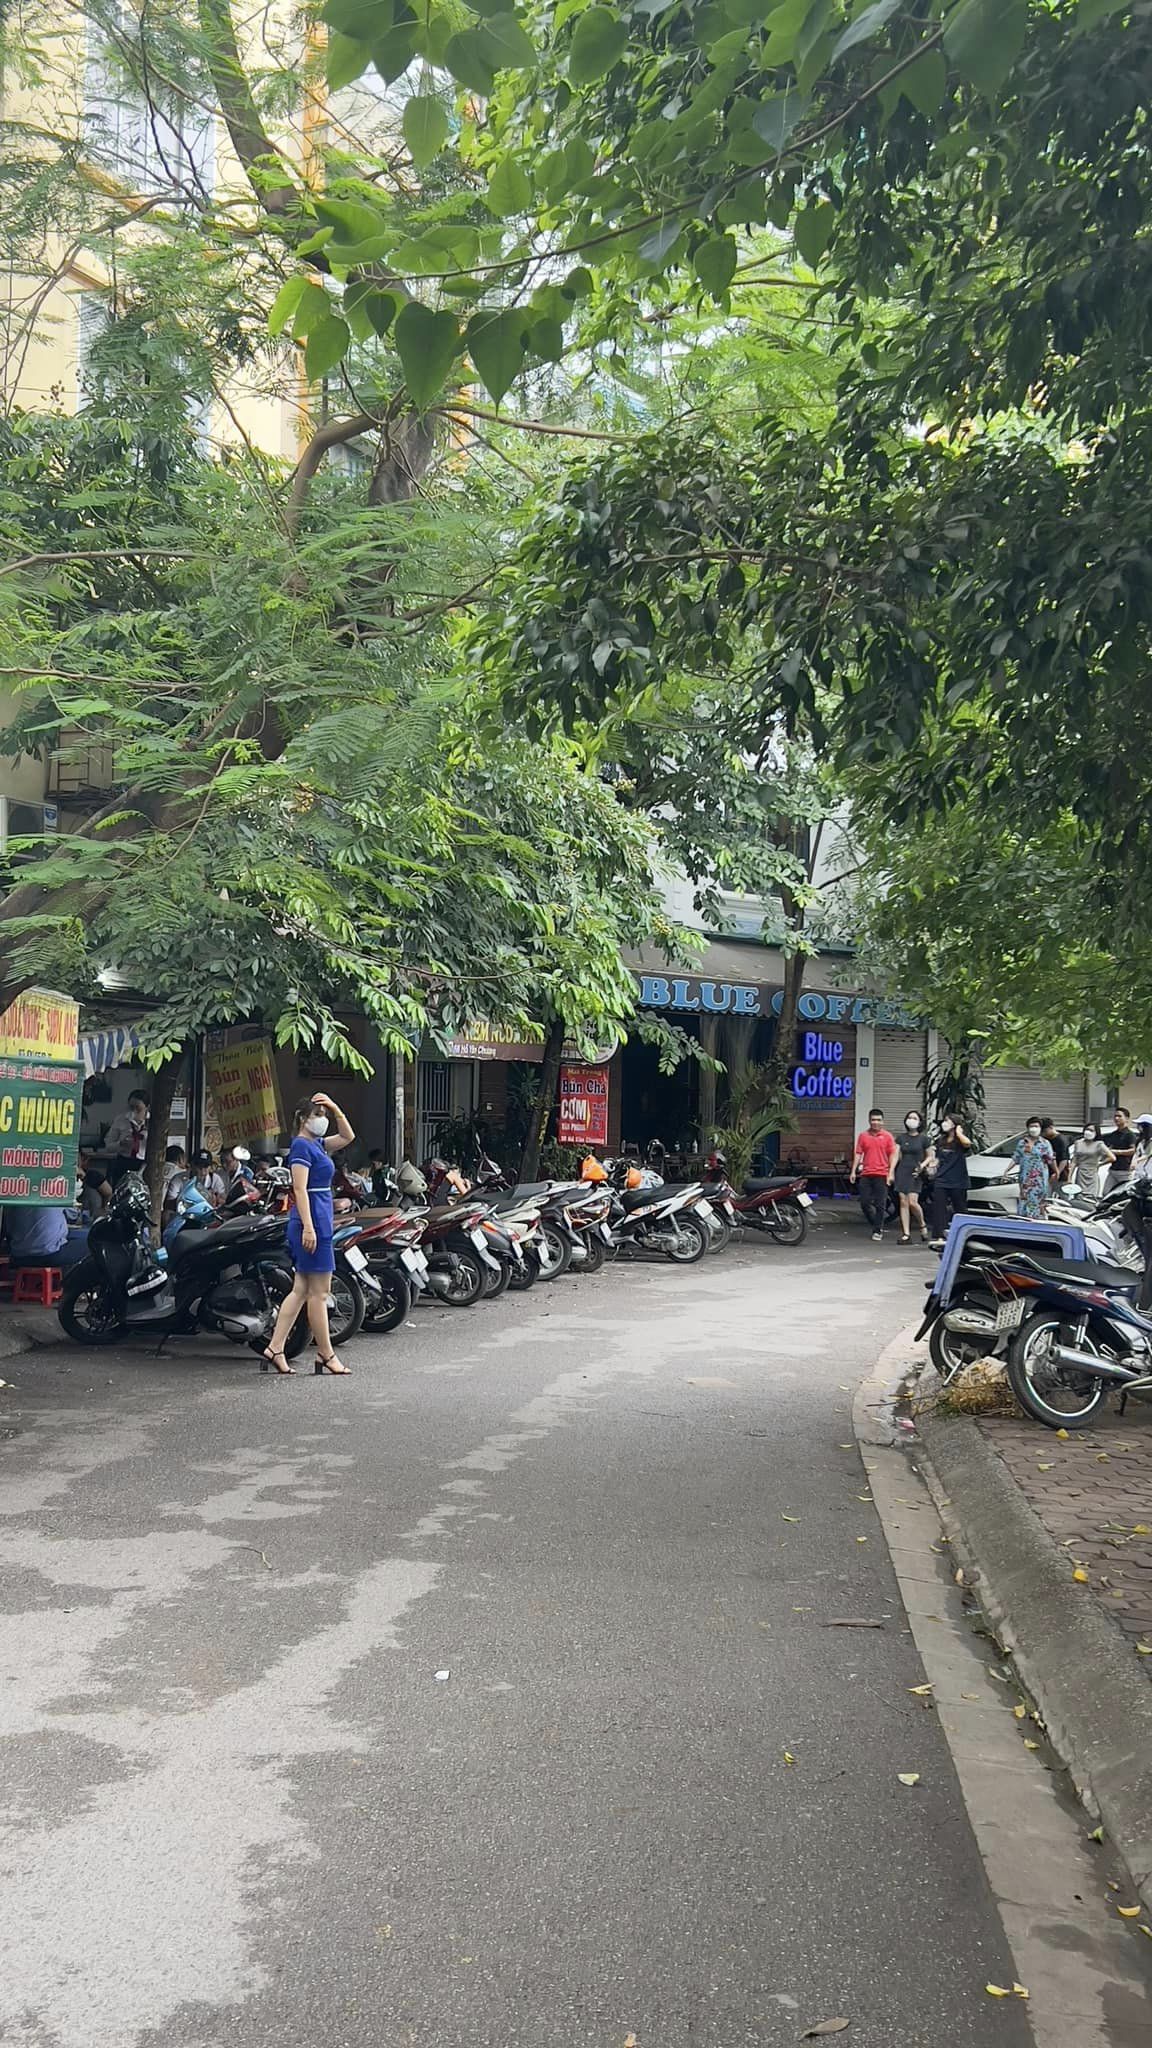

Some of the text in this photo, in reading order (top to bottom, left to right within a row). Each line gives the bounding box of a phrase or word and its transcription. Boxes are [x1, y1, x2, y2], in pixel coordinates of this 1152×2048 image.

[639, 975, 760, 1015] BLUE
[804, 1031, 843, 1063] Blue
[561, 1079, 583, 1095] Bún
[793, 1066, 854, 1098] Coffee
[17, 1090, 75, 1136] MÙNG
[561, 1097, 587, 1122] CƠM
